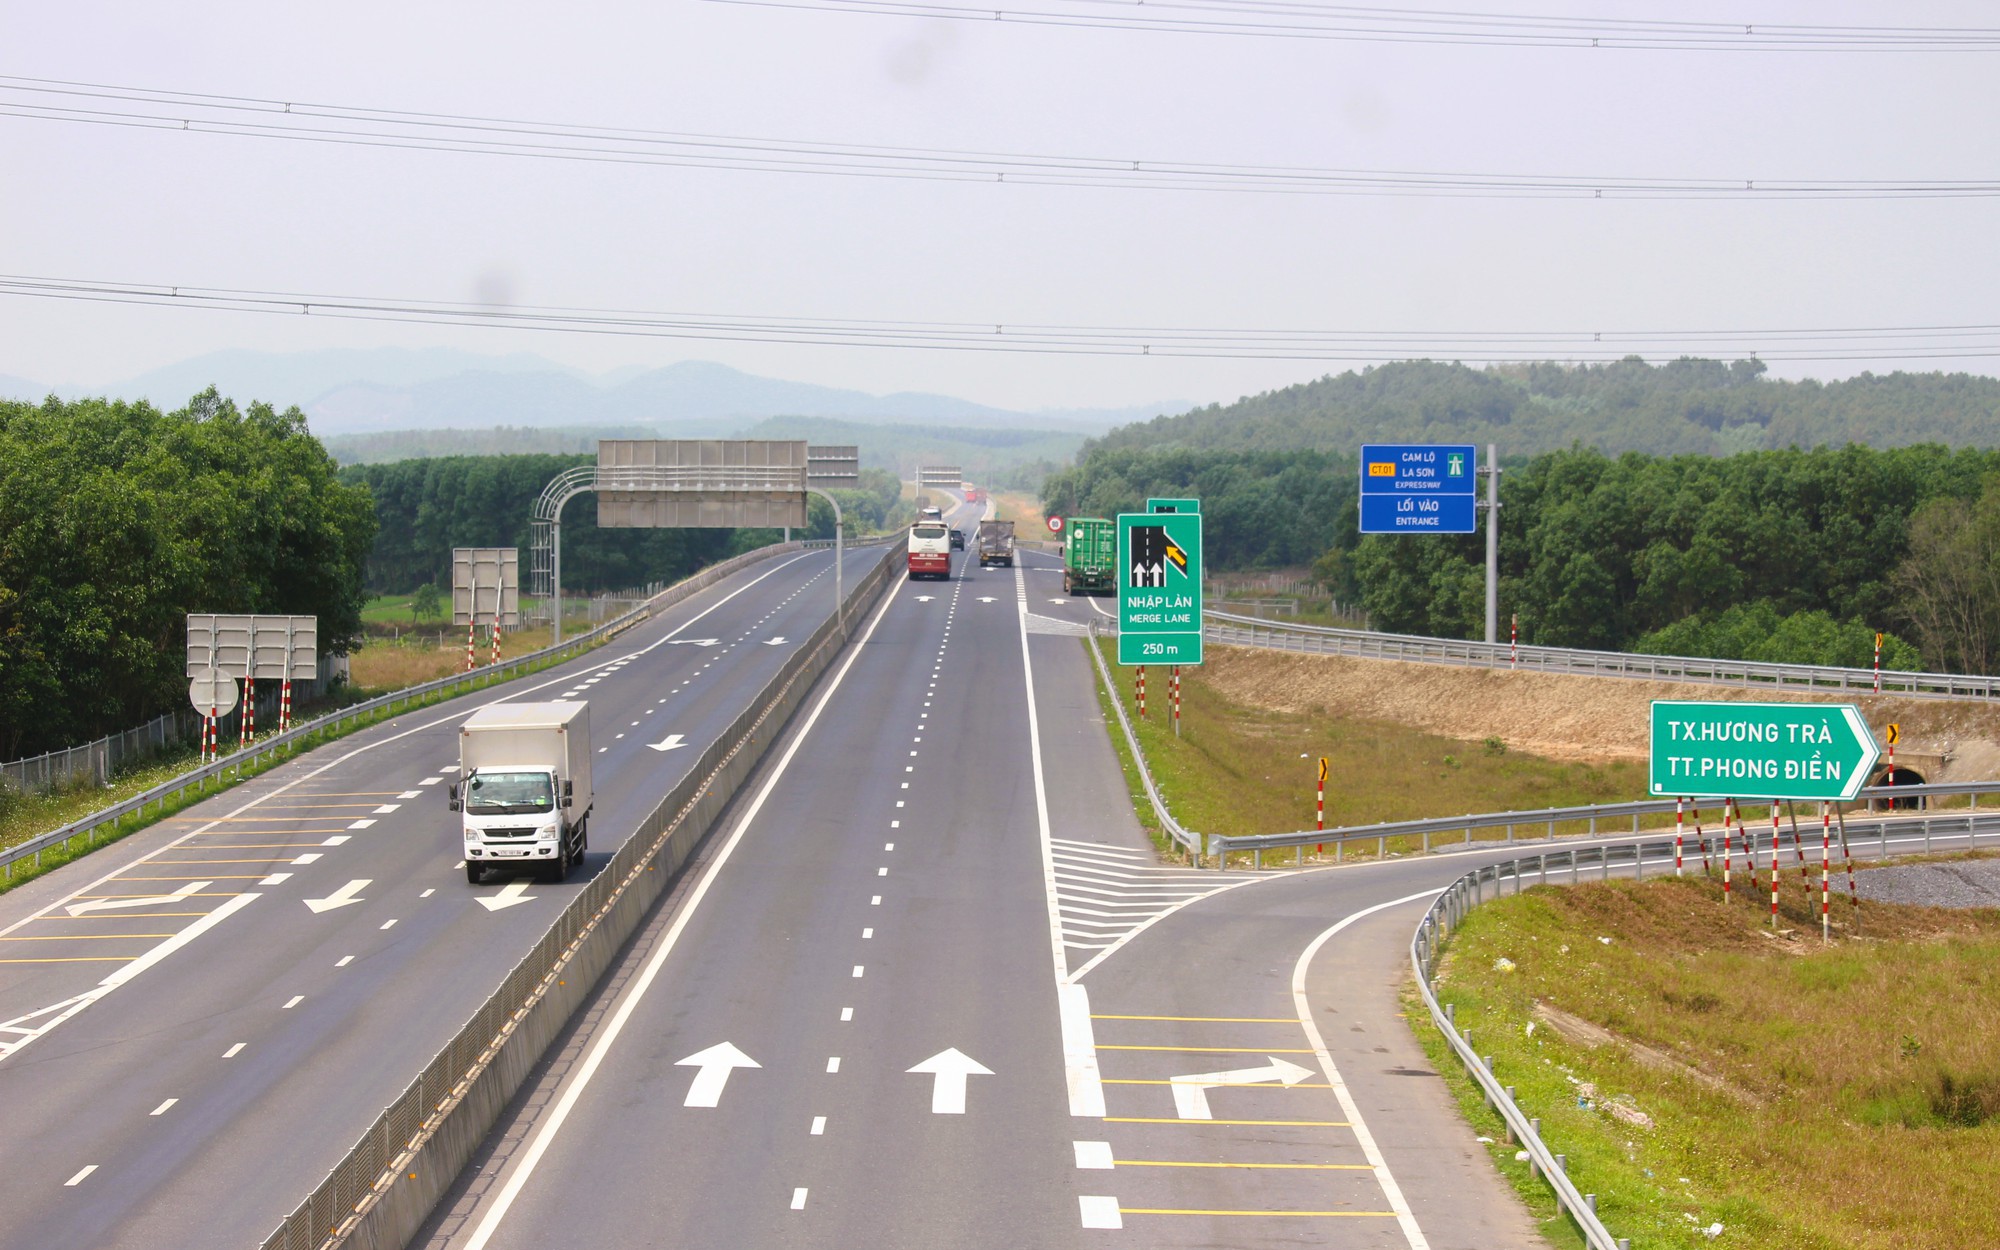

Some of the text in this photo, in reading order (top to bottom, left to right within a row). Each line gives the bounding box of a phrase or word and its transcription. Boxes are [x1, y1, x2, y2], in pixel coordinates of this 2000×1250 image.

[1402, 451, 1435, 463] CAM LỘ
[1372, 465, 1392, 474] CT.01
[1402, 468, 1434, 477] LA SƠN
[1398, 498, 1439, 511] LỐI VÀO
[1396, 517, 1439, 525] ENTRANCE
[1128, 593, 1192, 609] NHẬP LÀN
[1130, 614, 1190, 623] MERGE LANE
[1143, 643, 1178, 654] 250 m
[1668, 719, 1832, 743] TX.HƯƠNG TRÀ
[1668, 750, 1840, 780] TT.PHONG ĐIỀN
